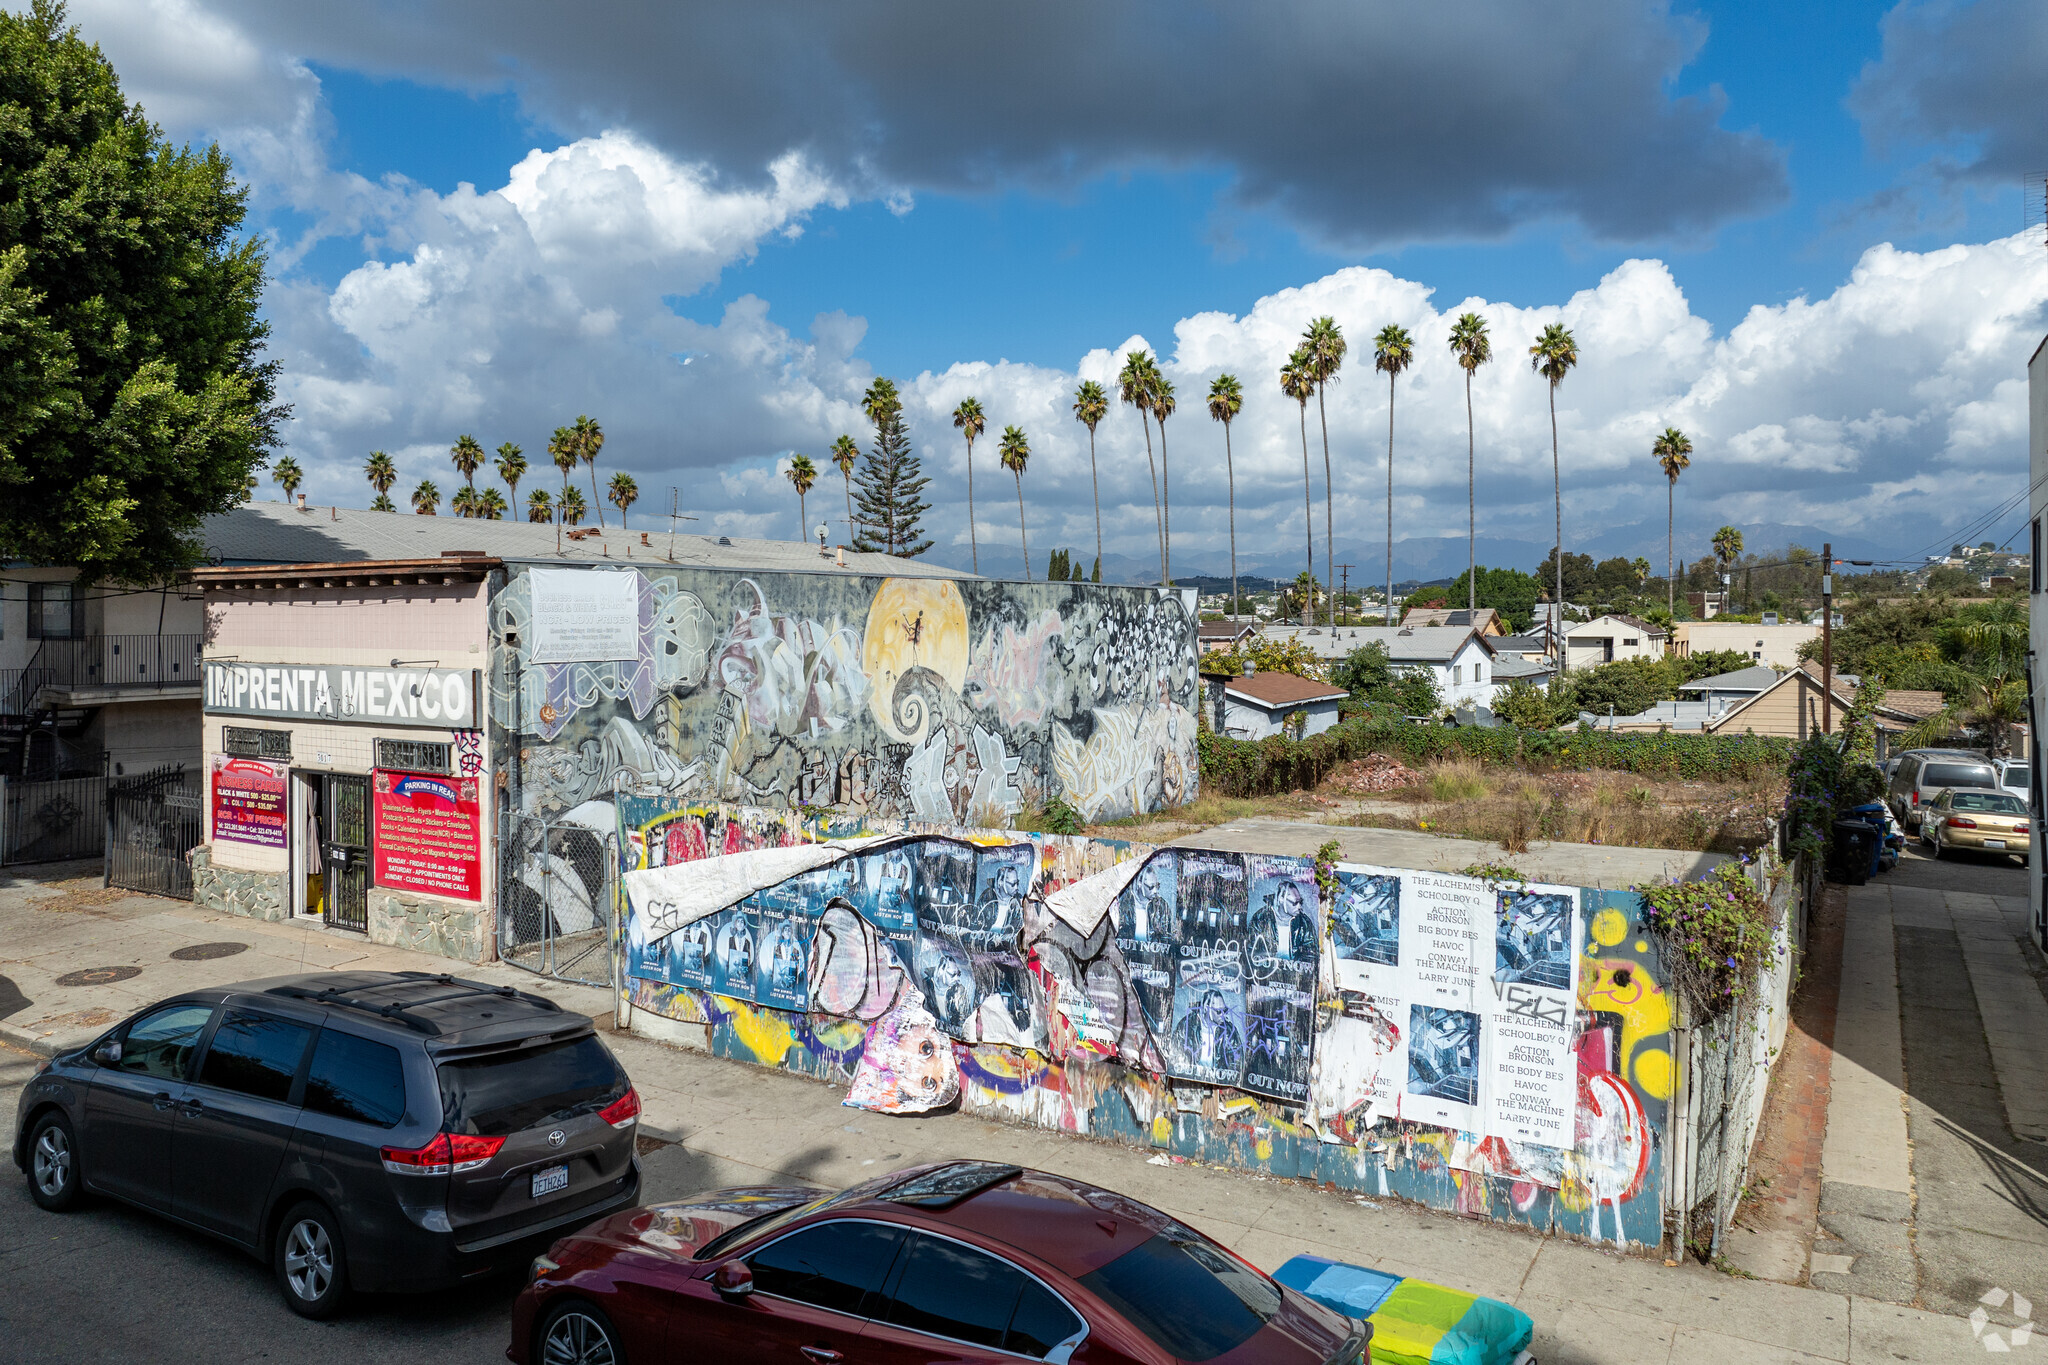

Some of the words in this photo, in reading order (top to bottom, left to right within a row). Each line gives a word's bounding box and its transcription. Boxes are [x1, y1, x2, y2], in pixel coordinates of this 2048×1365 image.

[537, 602, 564, 612] BLACK
[539, 615, 562, 624] NCR
[571, 615, 595, 624] LOW
[597, 615, 632, 624] PRICES
[207, 665, 334, 713] IMPRENTA
[341, 670, 467, 721] MEXICO
[254, 780, 284, 792] CARDS
[404, 782, 430, 790] PARKING
[218, 810, 232, 820] NCR
[254, 814, 282, 826] PRICES
[382, 802, 402, 812] Business
[402, 806, 414, 814] Cards
[418, 808, 432, 816] Flyers
[434, 810, 450, 818] Menus
[382, 812, 404, 822] Postcards
[408, 816, 422, 824] Tickets
[426, 818, 444, 826] Stickers
[448, 820, 470, 830] Envelopes
[380, 832, 400, 842] Invitations
[382, 822, 394, 830] Books
[398, 824, 418, 834] Calendars
[454, 832, 472, 840] Banners
[380, 842, 394, 850] Funeral
[394, 844, 406, 852] Cards
[408, 846, 418, 854] Flags
[428, 850, 446, 858] Magnets
[448, 852, 460, 860] Mugs
[462, 854, 476, 862] Shirts
[386, 856, 406, 864] MONDAY
[384, 872, 402, 882] SUNDAY
[406, 876, 424, 884] CLOSED
[436, 882, 452, 890] PHONE
[452, 882, 470, 892] CALLS
[388, 866, 412, 874] SATURDAY
[414, 868, 452, 880] APPOINTMENTS
[452, 874, 466, 882] ONLY
[1412, 876, 1431, 886] THE
[1433, 878, 1487, 893] ALCHEMIST
[1417, 889, 1472, 904] SCHOOLBOY
[1473, 896, 1481, 906] Q
[1426, 912, 1471, 925] BRONSON
[1431, 906, 1466, 917] ACTION
[1418, 924, 1434, 935] BIG
[1435, 927, 1460, 938] BODY
[1461, 930, 1479, 941] BES
[1115, 939, 1141, 952] OUT
[1140, 941, 1172, 955] NOW
[1432, 939, 1465, 952] HAVOC
[1281, 959, 1315, 974] NOW
[1415, 958, 1435, 969] THE
[1436, 961, 1480, 975] MACHINE
[1427, 952, 1468, 965] CONWAY
[1418, 971, 1450, 984] LARRY
[1451, 976, 1477, 988] JUNE
[1386, 1010, 1394, 1019] Q
[1492, 1013, 1513, 1024] THE
[1515, 1016, 1573, 1032] ALCHEMIST
[1498, 1027, 1556, 1044] SCHOOLBOY
[1557, 1036, 1566, 1046] Q
[1508, 1051, 1555, 1066] BRONSON
[1513, 1044, 1550, 1057] ACTION
[1173, 1062, 1203, 1078] OUT
[1204, 1065, 1240, 1082] NOW
[1498, 1063, 1515, 1074] BIG
[1517, 1066, 1543, 1078] BODY
[1545, 1070, 1564, 1082] BES
[1247, 1072, 1275, 1090] OUT
[1275, 1077, 1310, 1097] NOW
[1514, 1079, 1548, 1093] HAVOC
[1495, 1097, 1516, 1109] THE
[1518, 1101, 1565, 1118] MACHINE
[1509, 1092, 1552, 1107] CONWAY
[1499, 1111, 1532, 1125] LARRY
[1533, 1117, 1561, 1130] JUNE
